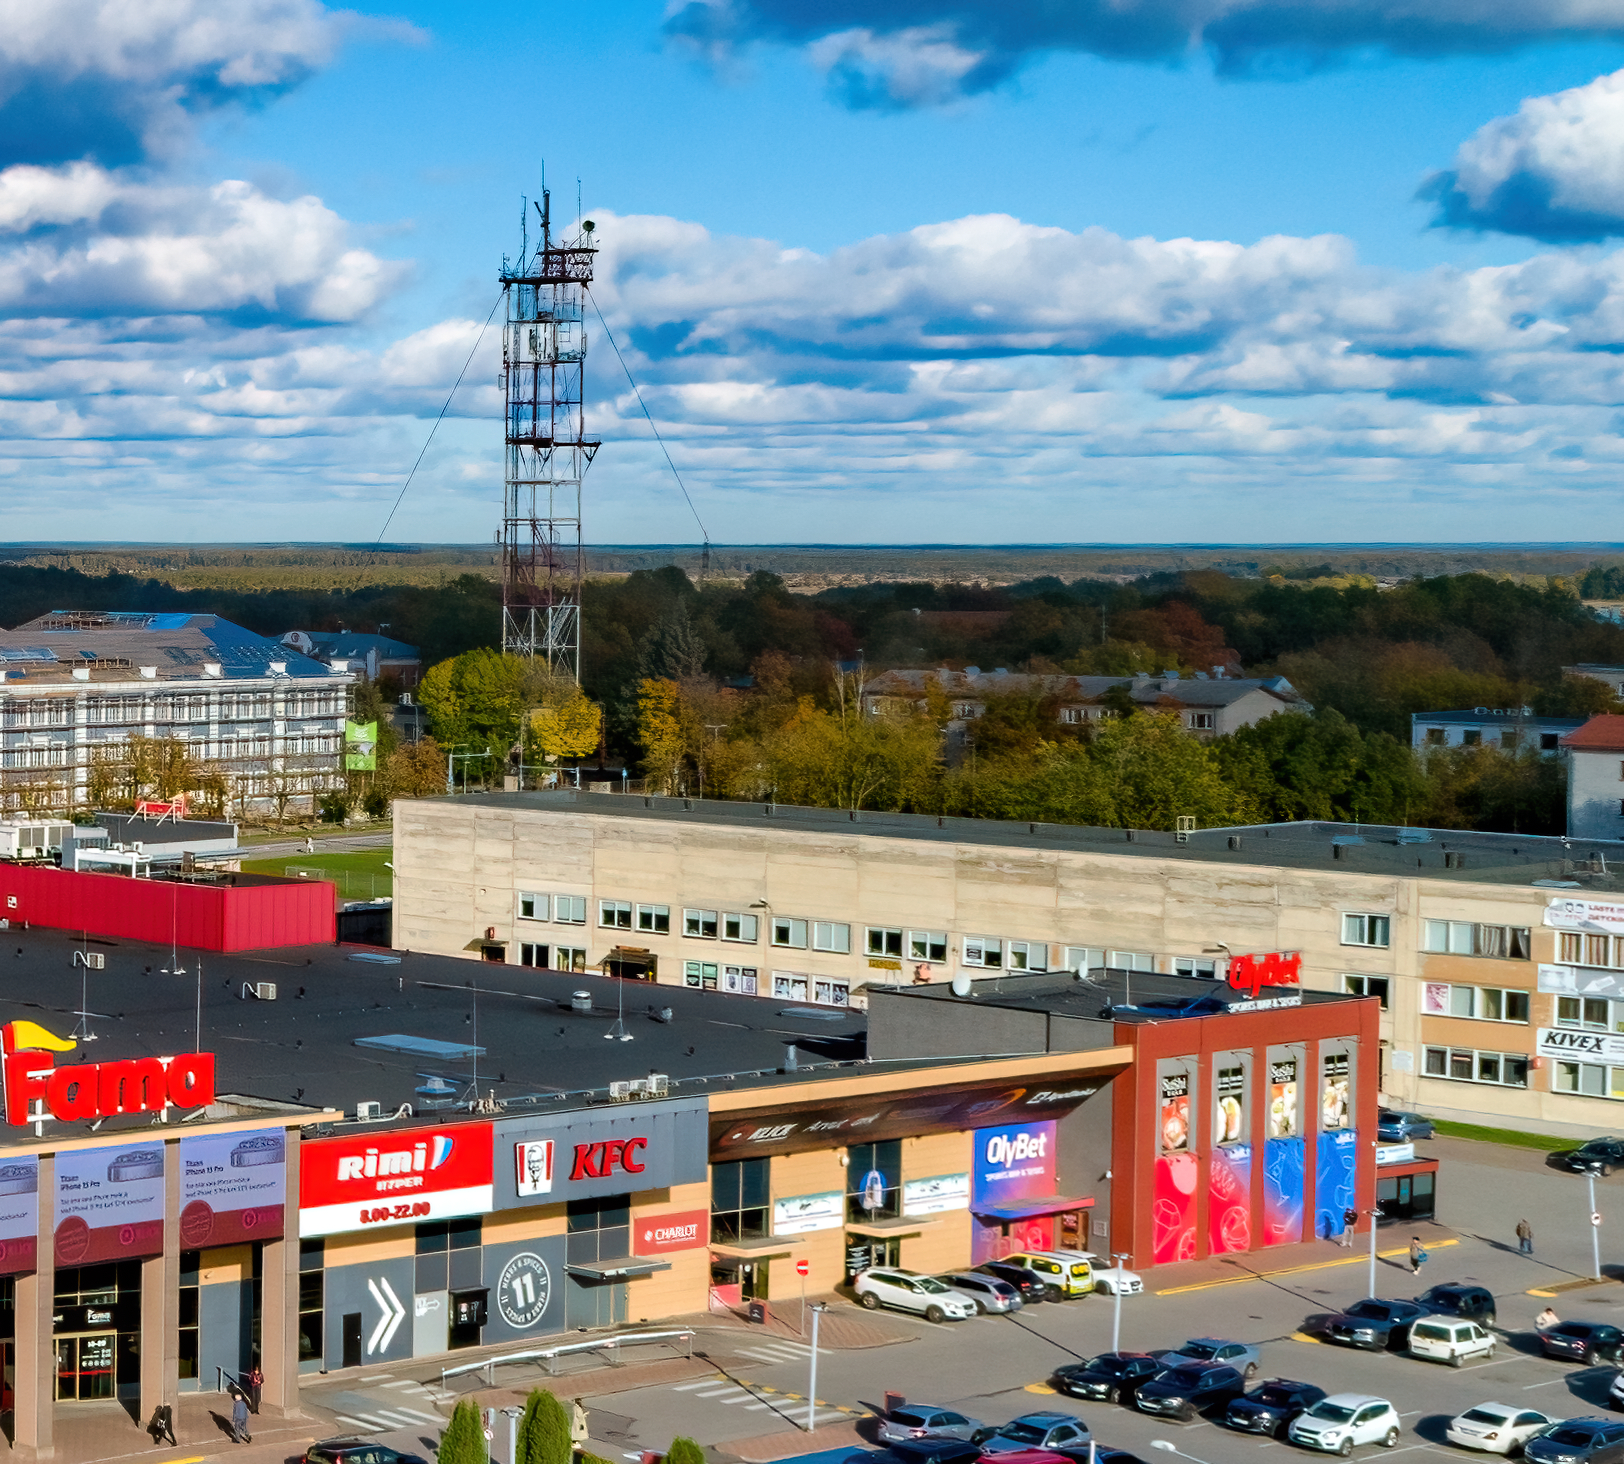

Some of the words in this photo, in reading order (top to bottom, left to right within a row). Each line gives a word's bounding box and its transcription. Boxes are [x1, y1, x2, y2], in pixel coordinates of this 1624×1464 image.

[0, 1021, 216, 1126] Fama
[337, 1143, 428, 1181] Rimi
[569, 1137, 648, 1181] KFC
[987, 1132, 1047, 1168] OlyBet
[511, 1272, 536, 1309] 11
